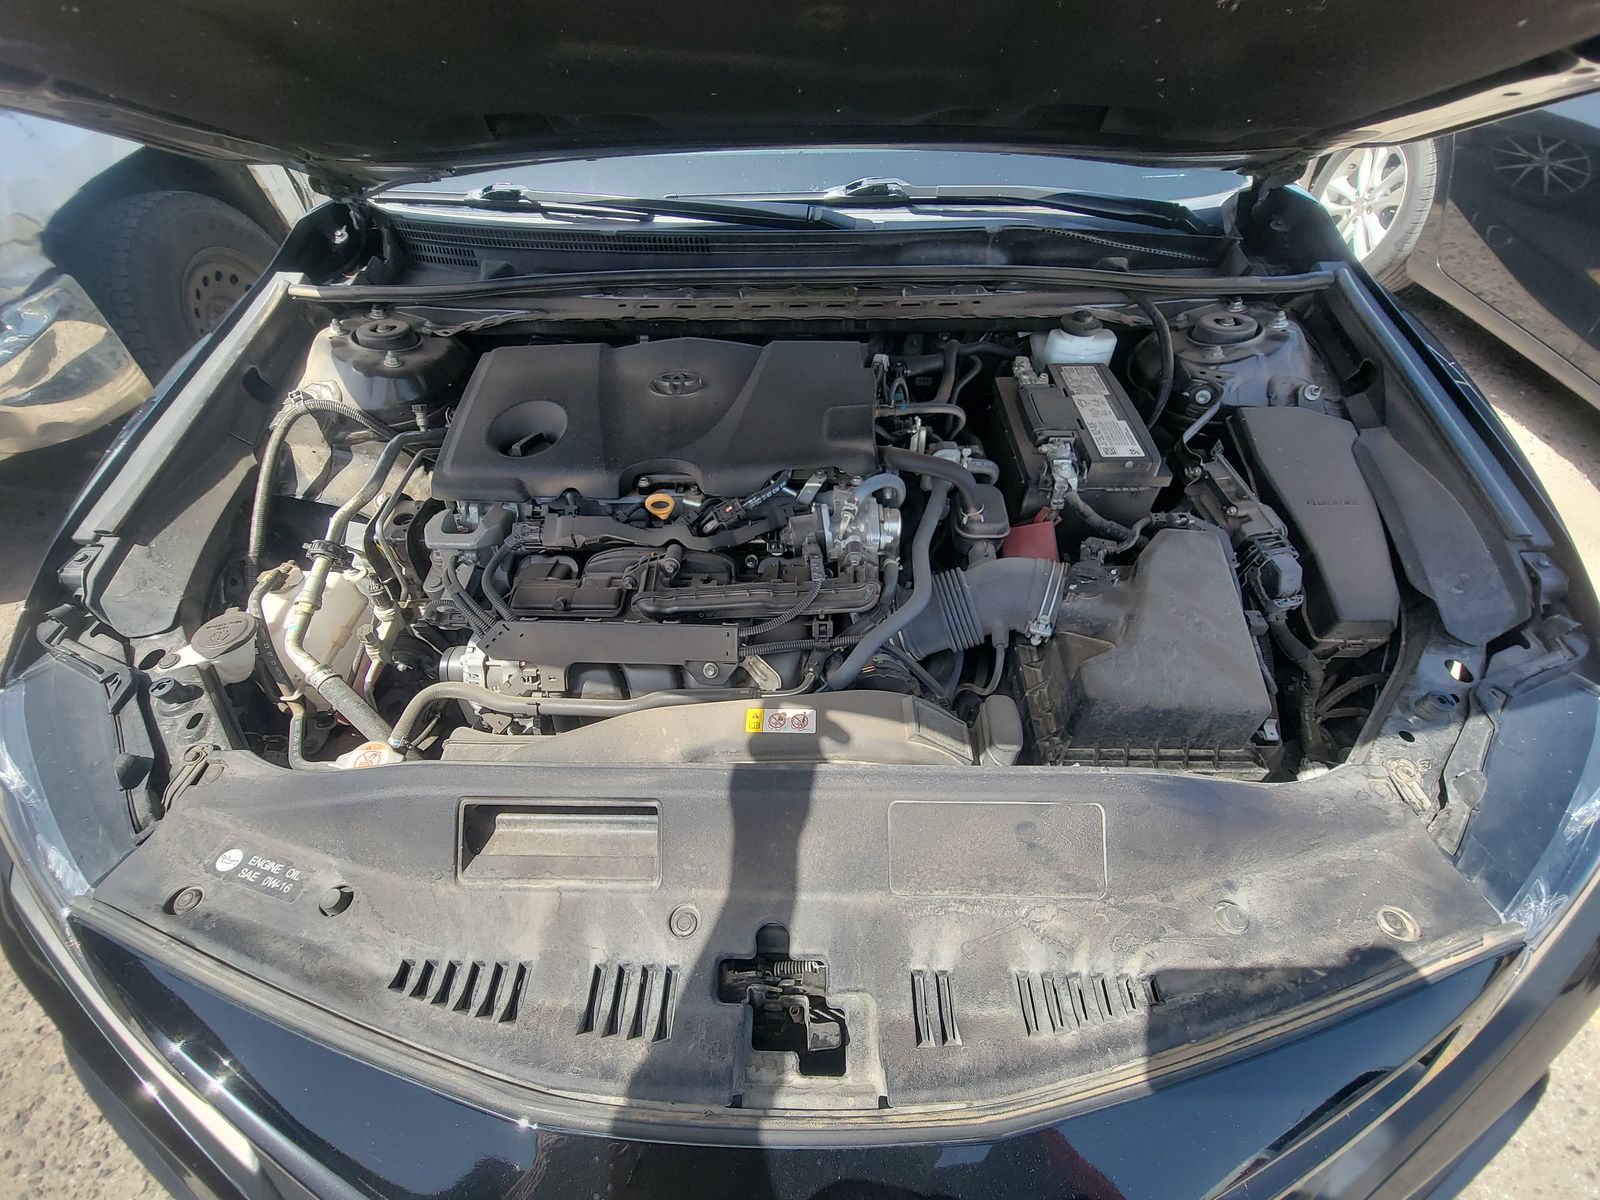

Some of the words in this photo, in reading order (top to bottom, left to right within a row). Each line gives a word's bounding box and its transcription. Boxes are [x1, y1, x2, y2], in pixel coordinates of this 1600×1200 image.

[237, 867, 261, 882] SAE
[261, 876, 293, 893] 0W-16
[248, 855, 284, 874] ENGINE
[285, 868, 301, 881] OIL
